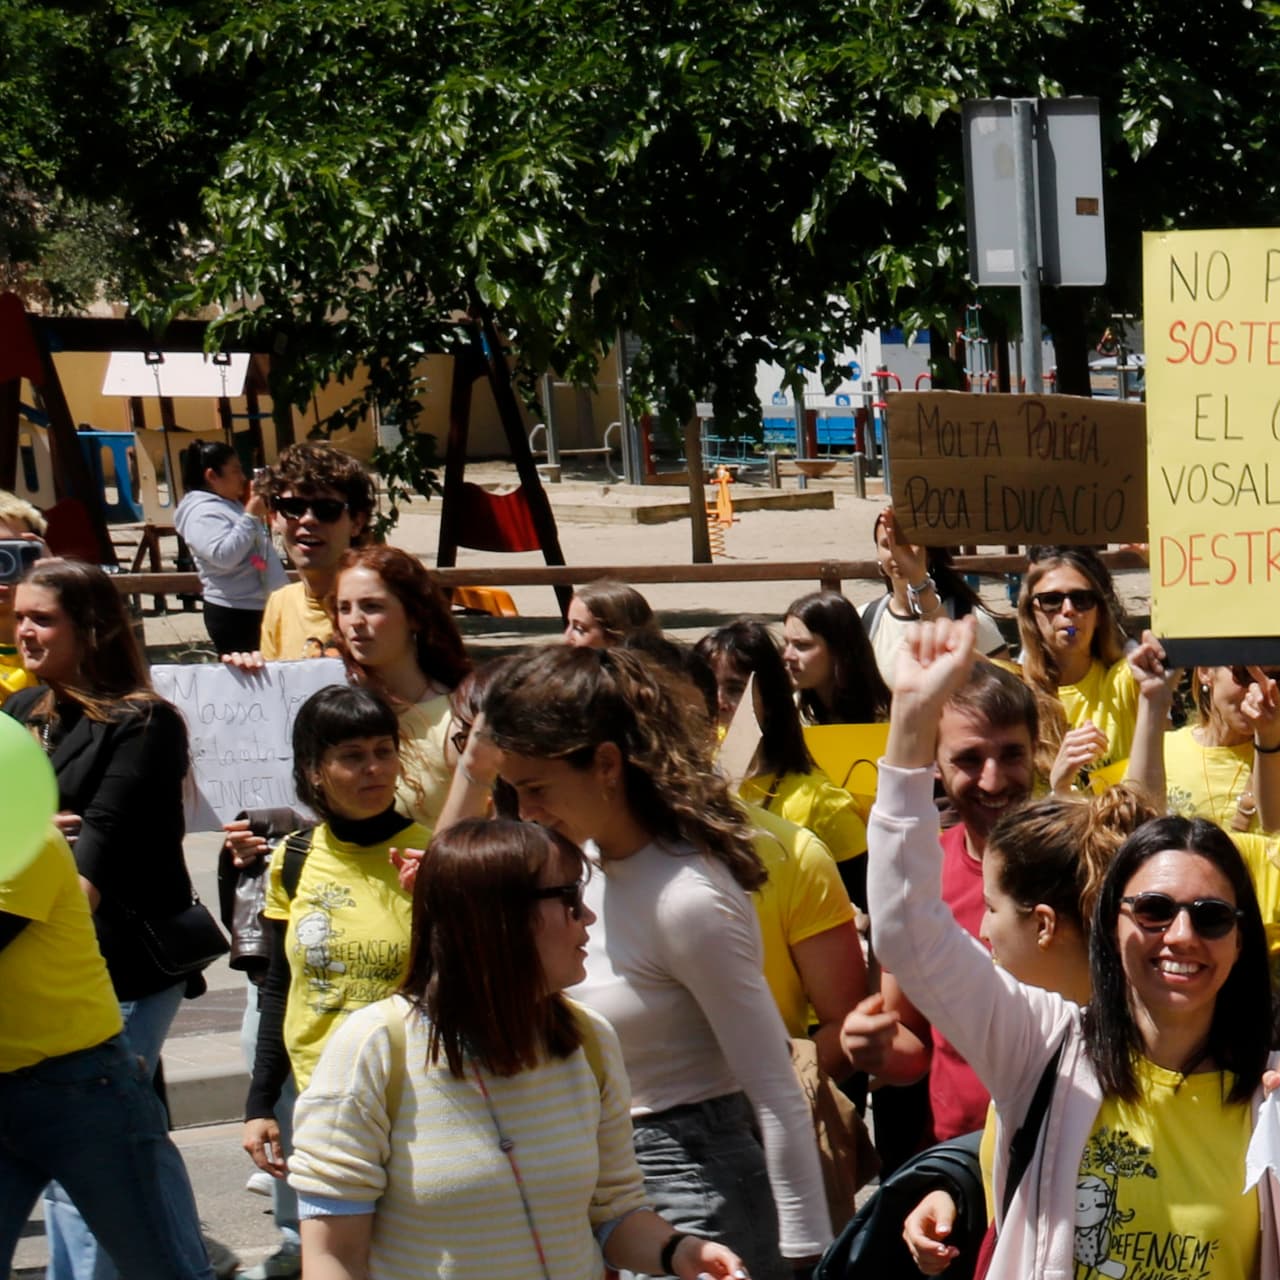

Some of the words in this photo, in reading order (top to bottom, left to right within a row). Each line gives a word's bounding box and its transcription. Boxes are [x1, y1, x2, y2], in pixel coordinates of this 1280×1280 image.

[1170, 250, 1231, 303] NO
[916, 402, 1002, 459] MOLTA
[1194, 394, 1244, 442] EL
[903, 474, 971, 530] POCA
[1110, 1230, 1211, 1274] DEFENSEM
